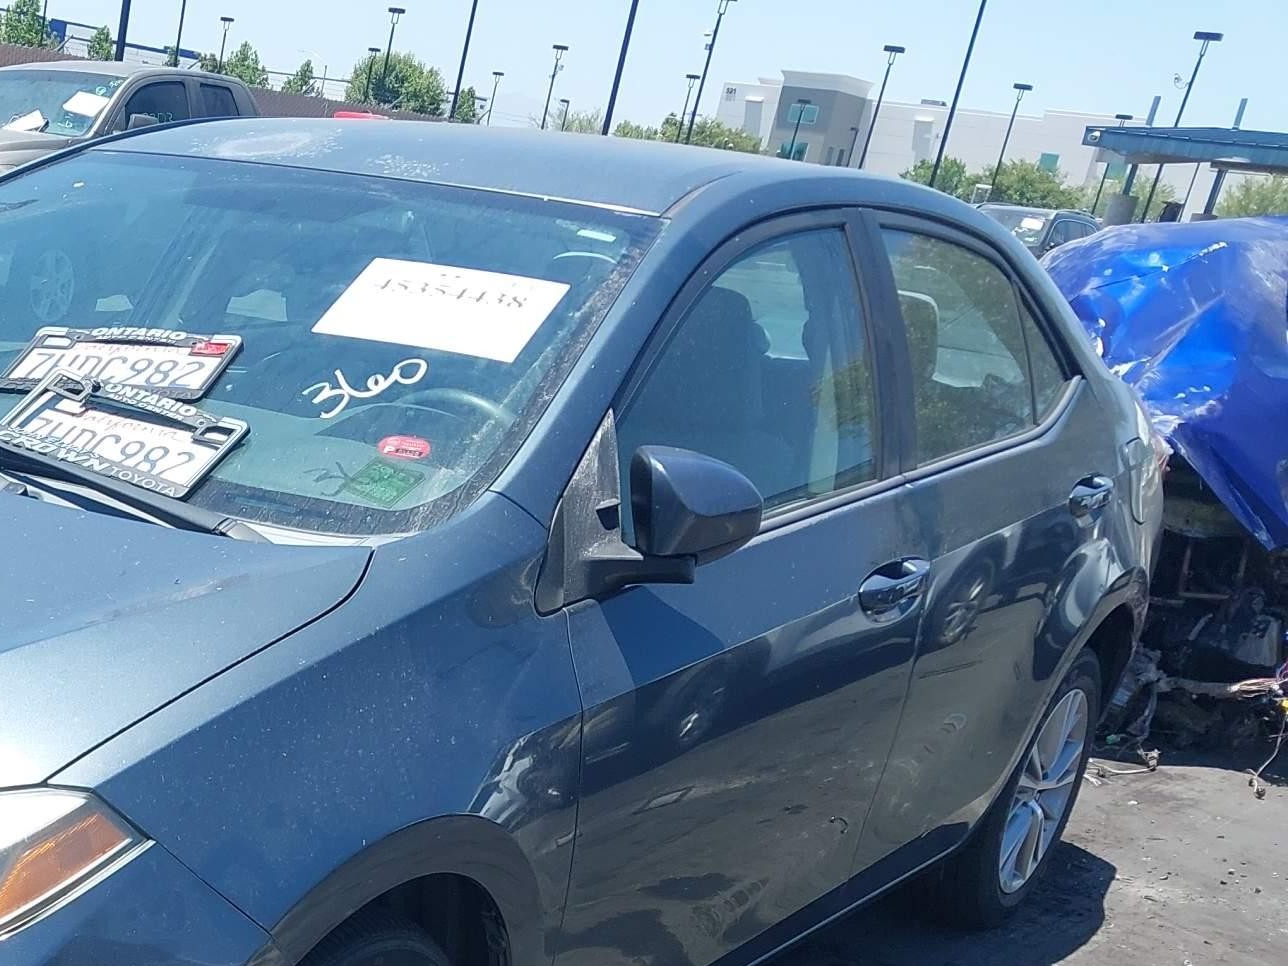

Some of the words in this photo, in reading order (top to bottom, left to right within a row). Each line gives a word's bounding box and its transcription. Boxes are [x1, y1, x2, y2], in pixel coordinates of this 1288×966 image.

[91, 327, 188, 341] ONTARIO
[104, 383, 198, 416] ONTARIO
[107, 393, 137, 406] AUTO
[138, 403, 185, 421] CENTER
[110, 466, 177, 498] TOYOTA
